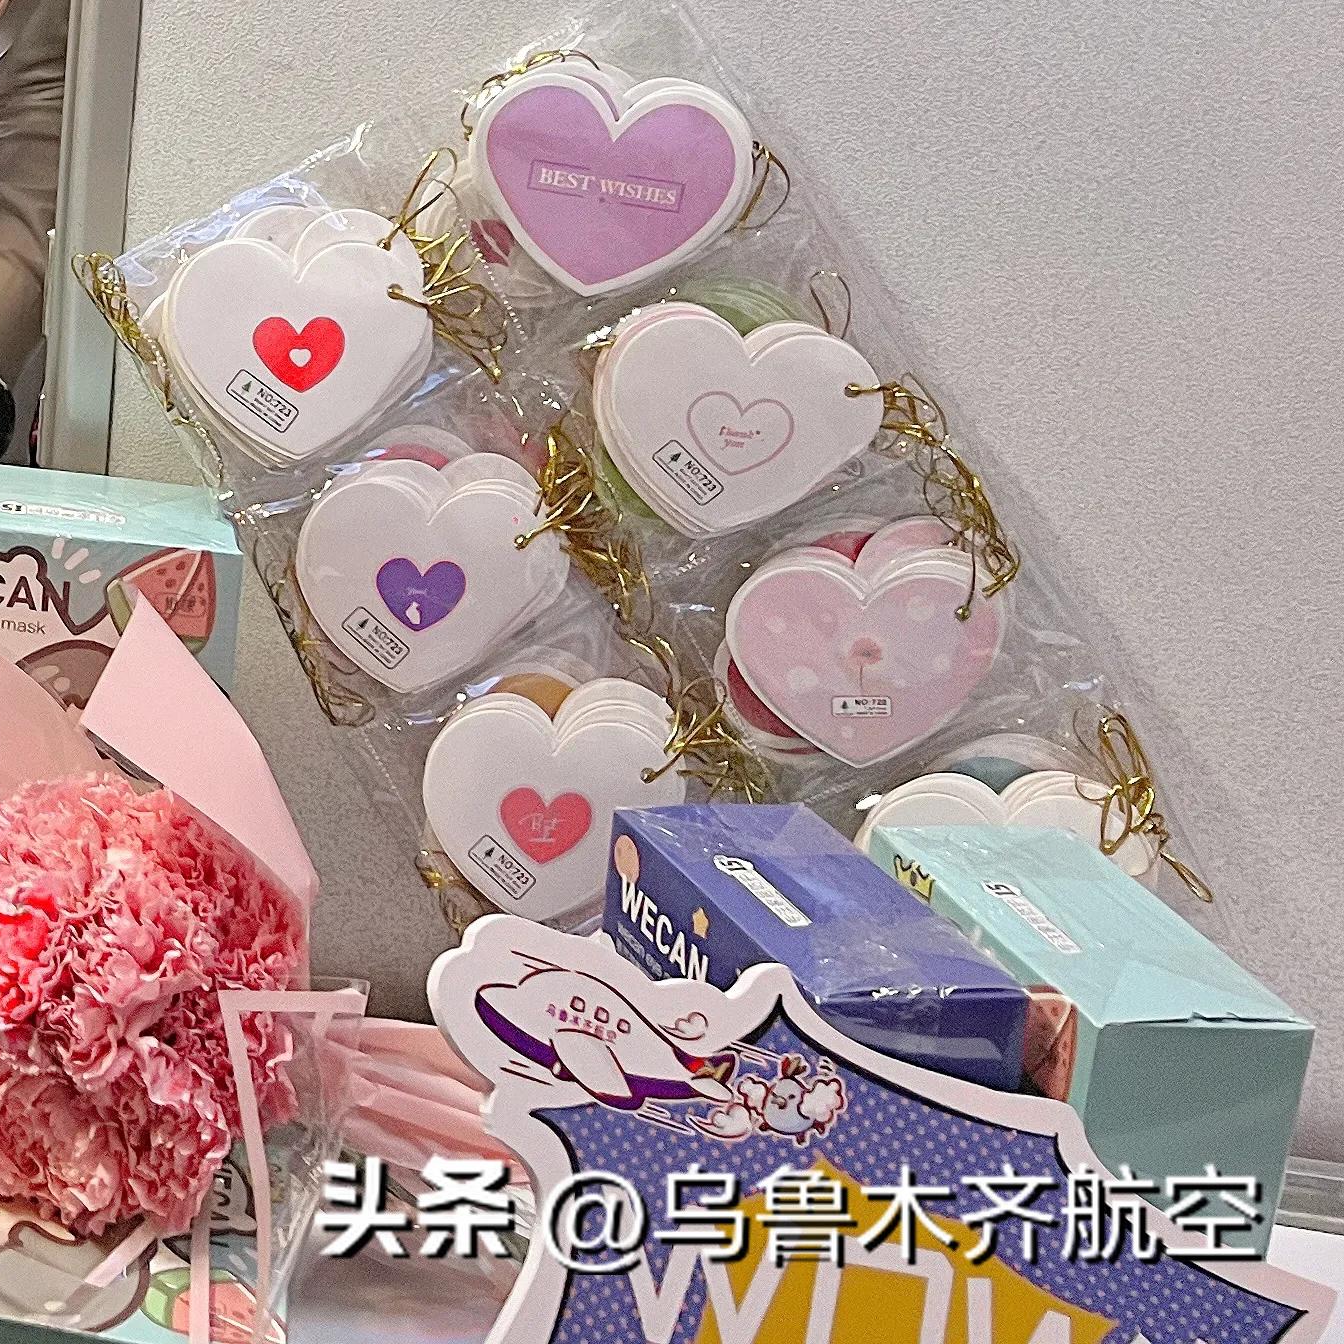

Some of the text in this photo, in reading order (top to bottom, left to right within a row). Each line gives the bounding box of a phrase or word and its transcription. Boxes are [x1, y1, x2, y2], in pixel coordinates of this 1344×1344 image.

[538, 168, 677, 205] BEST WISHES
[0, 618, 47, 636] mask
[620, 874, 709, 982] WECAN
